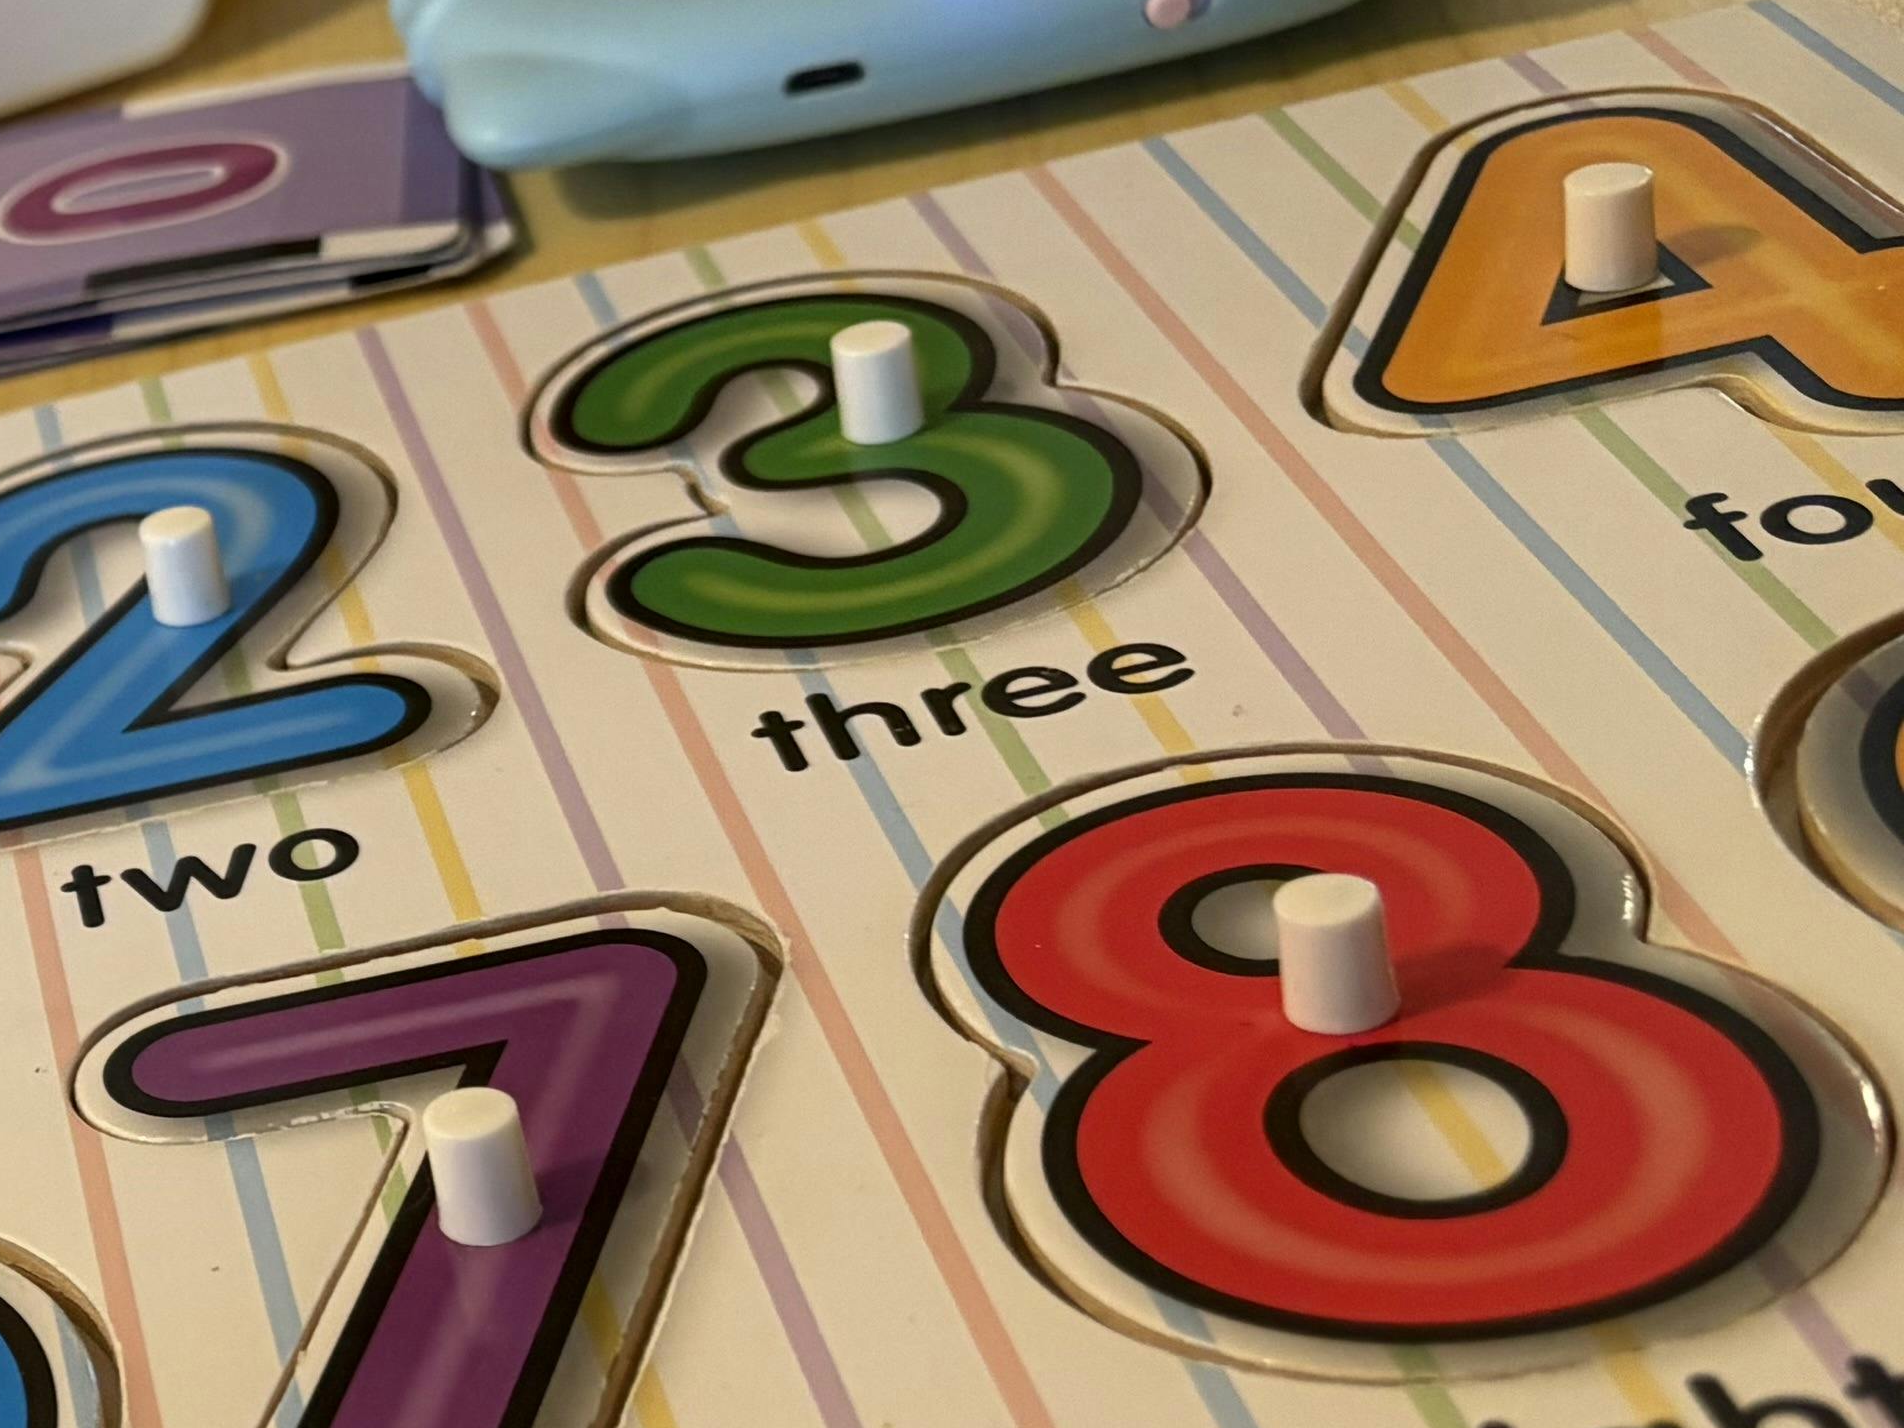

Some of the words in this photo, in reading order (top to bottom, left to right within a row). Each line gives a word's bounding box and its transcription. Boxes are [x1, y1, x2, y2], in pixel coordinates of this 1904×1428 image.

[545, 292, 1147, 649] 3
[1682, 477, 1904, 562] fo
[752, 640, 1196, 775] three
[59, 823, 362, 930] two
[963, 772, 1822, 1345] 8
